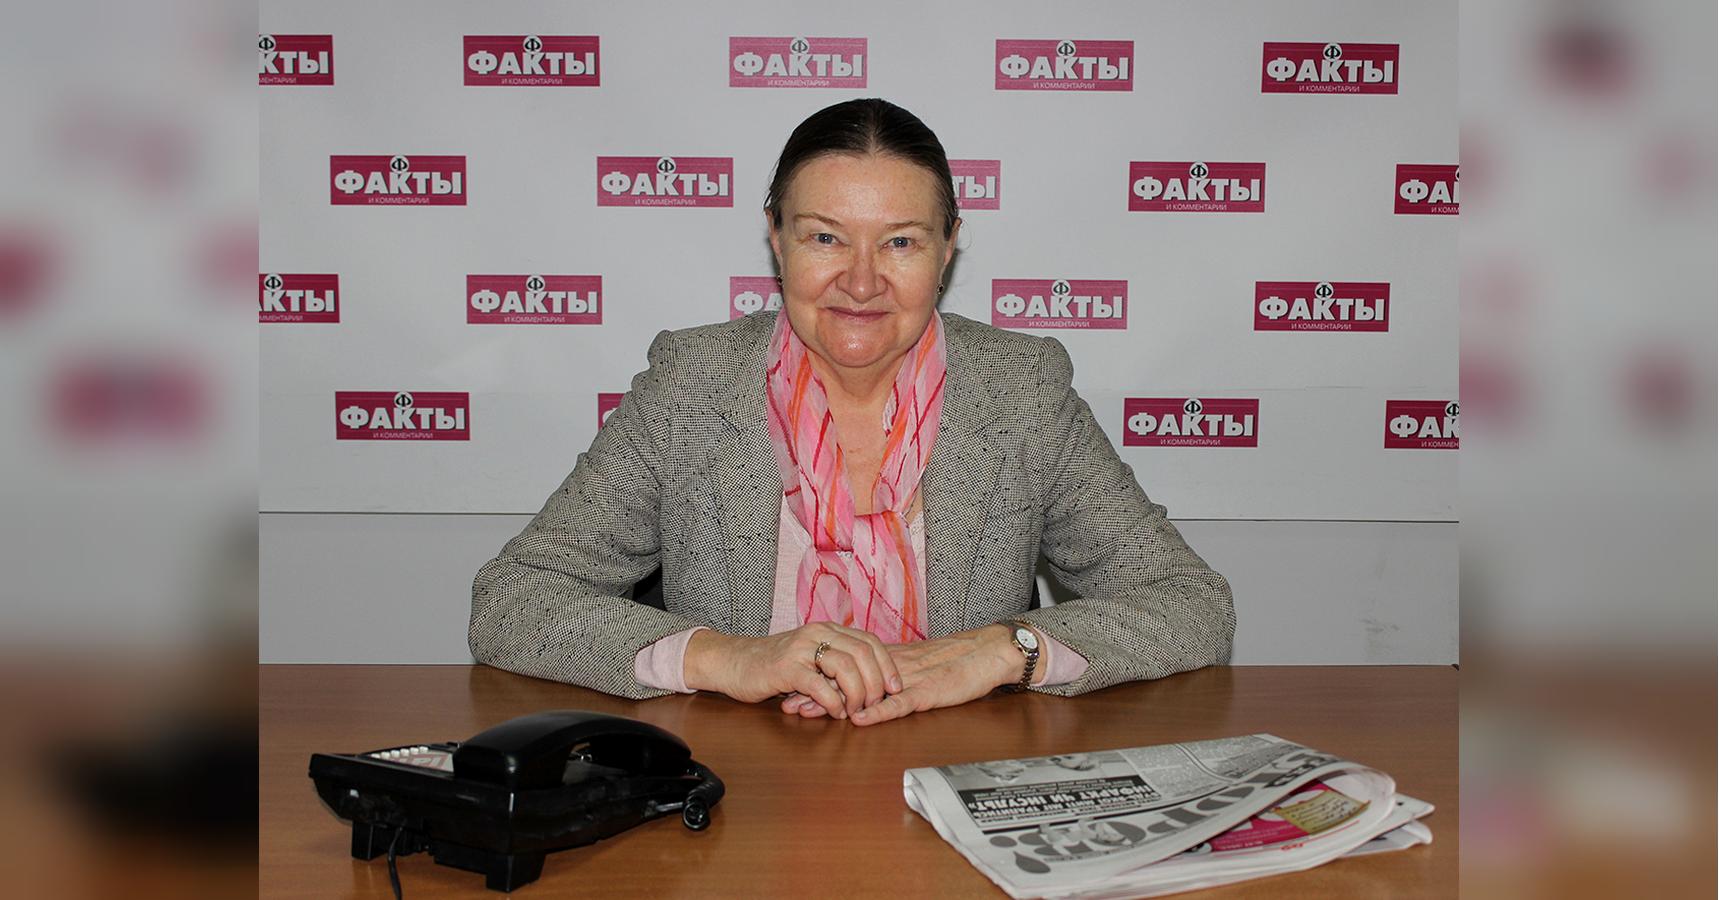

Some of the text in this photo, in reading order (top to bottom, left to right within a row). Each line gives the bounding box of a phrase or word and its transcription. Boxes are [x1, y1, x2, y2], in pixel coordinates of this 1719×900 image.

[259, 51, 329, 74] КТЫ
[467, 50, 595, 75] ФАКТЫ
[733, 52, 863, 76] ФАКТЫ
[999, 54, 1129, 79] ФАКТЫ
[1266, 57, 1394, 83] ФАКТЫ
[334, 170, 462, 195] ФАКТЫ
[601, 171, 729, 196] ФАКТЫ
[1133, 176, 1260, 201] ФАКТЫ
[1166, 203, 1227, 211] И КОММЕНТАРИИ
[263, 289, 334, 312] КТЫ
[471, 289, 597, 313] ФАКТЫ
[995, 293, 1122, 318] ФАКТЫ
[1259, 296, 1384, 320] ФАКТЫ
[340, 406, 465, 429] ФАКТЫ
[1128, 412, 1253, 436] ФАКТЫ
[1389, 414, 1459, 438] ФАК
